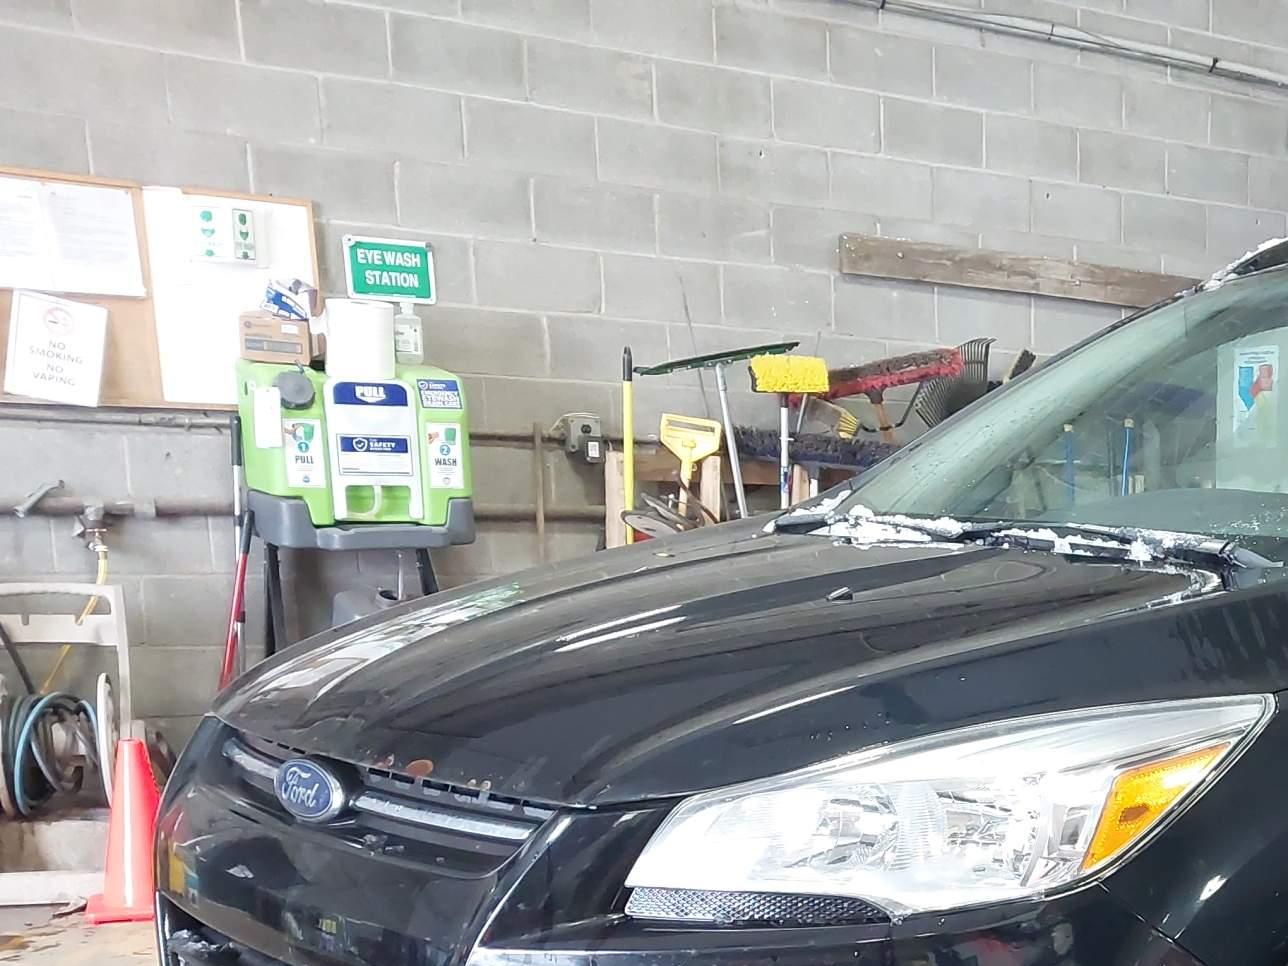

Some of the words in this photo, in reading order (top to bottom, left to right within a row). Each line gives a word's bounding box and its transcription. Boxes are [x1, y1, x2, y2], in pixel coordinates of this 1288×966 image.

[356, 248, 382, 265] EYE
[382, 250, 421, 268] WASH
[364, 269, 420, 288] STATION
[48, 340, 66, 351] NO
[29, 345, 84, 365] SMOKING
[46, 363, 64, 374] NO
[32, 371, 77, 387] VAPING
[355, 385, 386, 398] PULL
[294, 455, 315, 465] PULL
[434, 457, 458, 467] WASH
[282, 767, 320, 807] Ford
